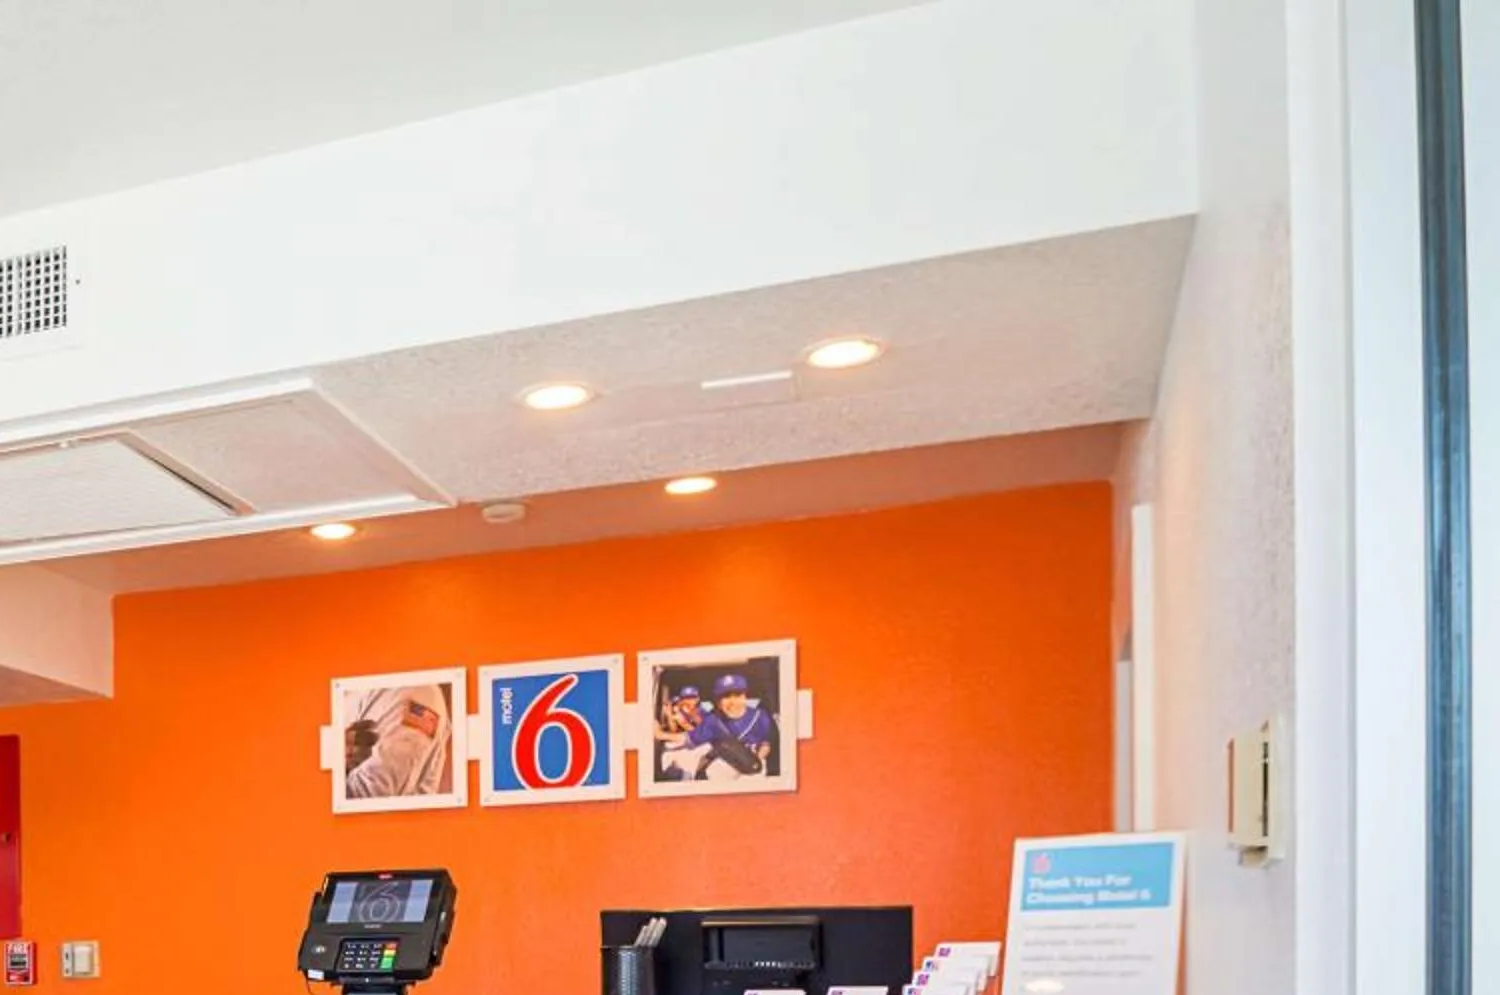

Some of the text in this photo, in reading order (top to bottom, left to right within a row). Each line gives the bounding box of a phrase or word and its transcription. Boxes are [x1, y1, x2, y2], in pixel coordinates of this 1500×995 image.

[500, 673, 596, 790] motel 6
[1028, 874, 1132, 889] Thank You For
[1027, 891, 1094, 906] Choosing
